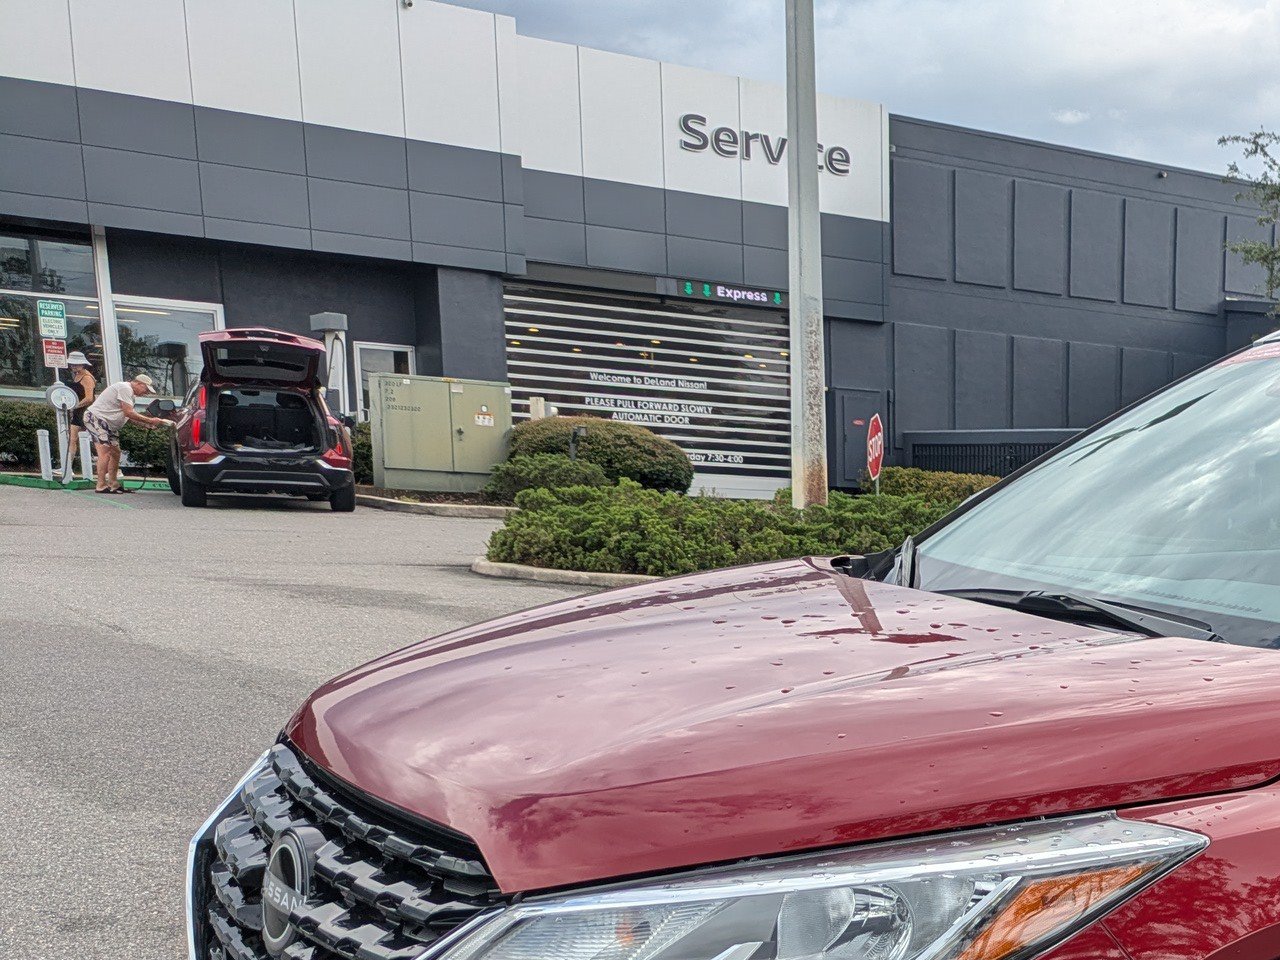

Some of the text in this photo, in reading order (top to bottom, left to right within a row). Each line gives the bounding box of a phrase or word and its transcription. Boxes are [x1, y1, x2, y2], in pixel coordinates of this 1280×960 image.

[680, 113, 851, 176] Serve
[716, 285, 768, 302] Express
[40, 302, 63, 310] RESERVED
[590, 372, 632, 384] Welcome
[632, 375, 643, 384] to
[644, 377, 676, 387] DeLand
[584, 397, 713, 414] PLEASE PULL FORWARD SLOWLY
[612, 411, 691, 425] AUTOMATIC DOOR
[868, 431, 882, 463] STOP
[687, 452, 744, 464] rday 7:30-4:00
